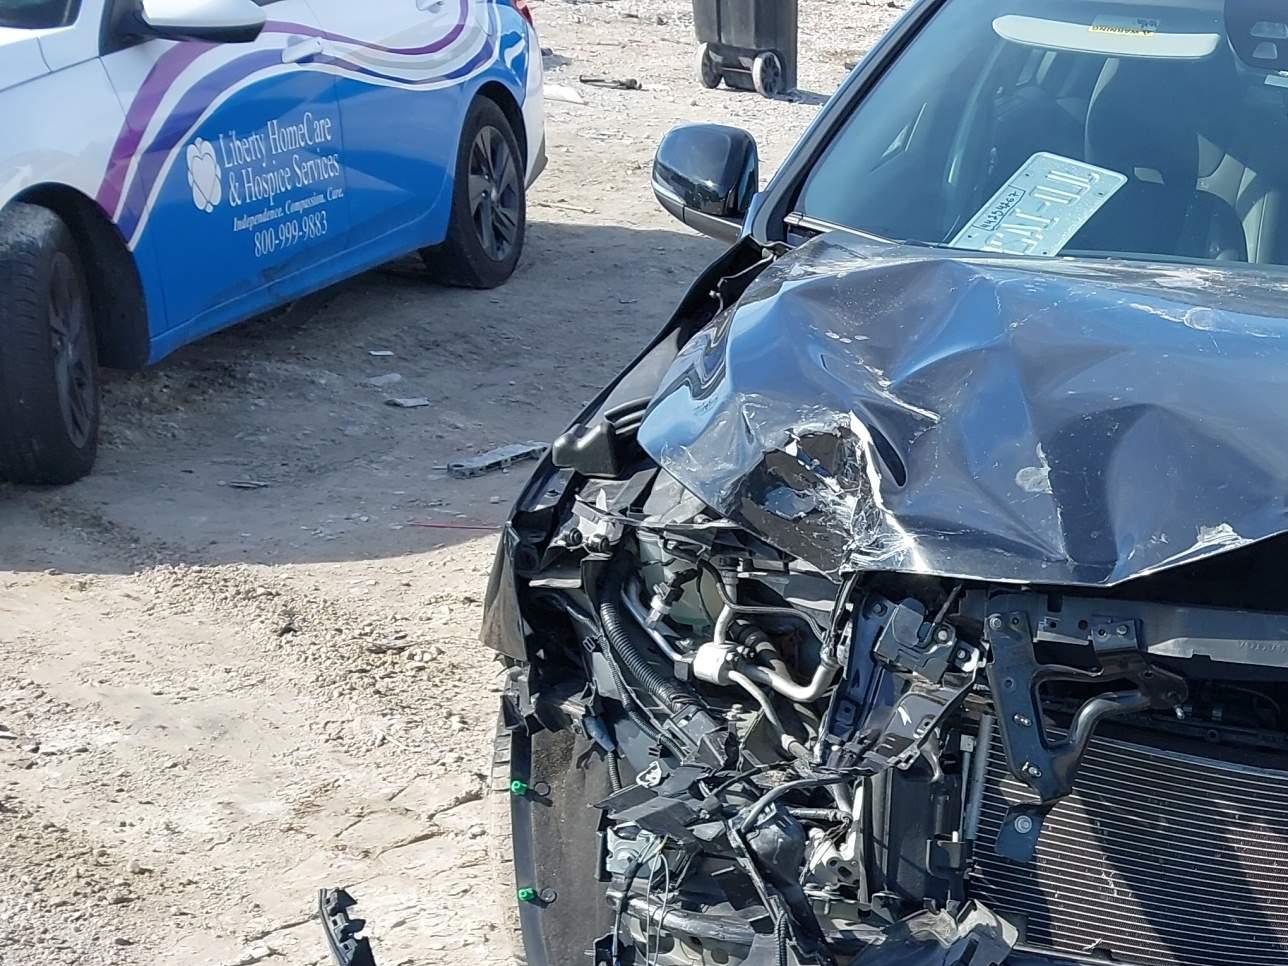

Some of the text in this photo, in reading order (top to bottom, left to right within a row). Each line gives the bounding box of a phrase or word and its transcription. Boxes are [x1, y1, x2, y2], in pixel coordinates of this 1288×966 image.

[219, 112, 332, 168] Liberty HomeCare
[228, 148, 340, 207] & Hospice Services
[254, 210, 328, 257] 800-999-9883
